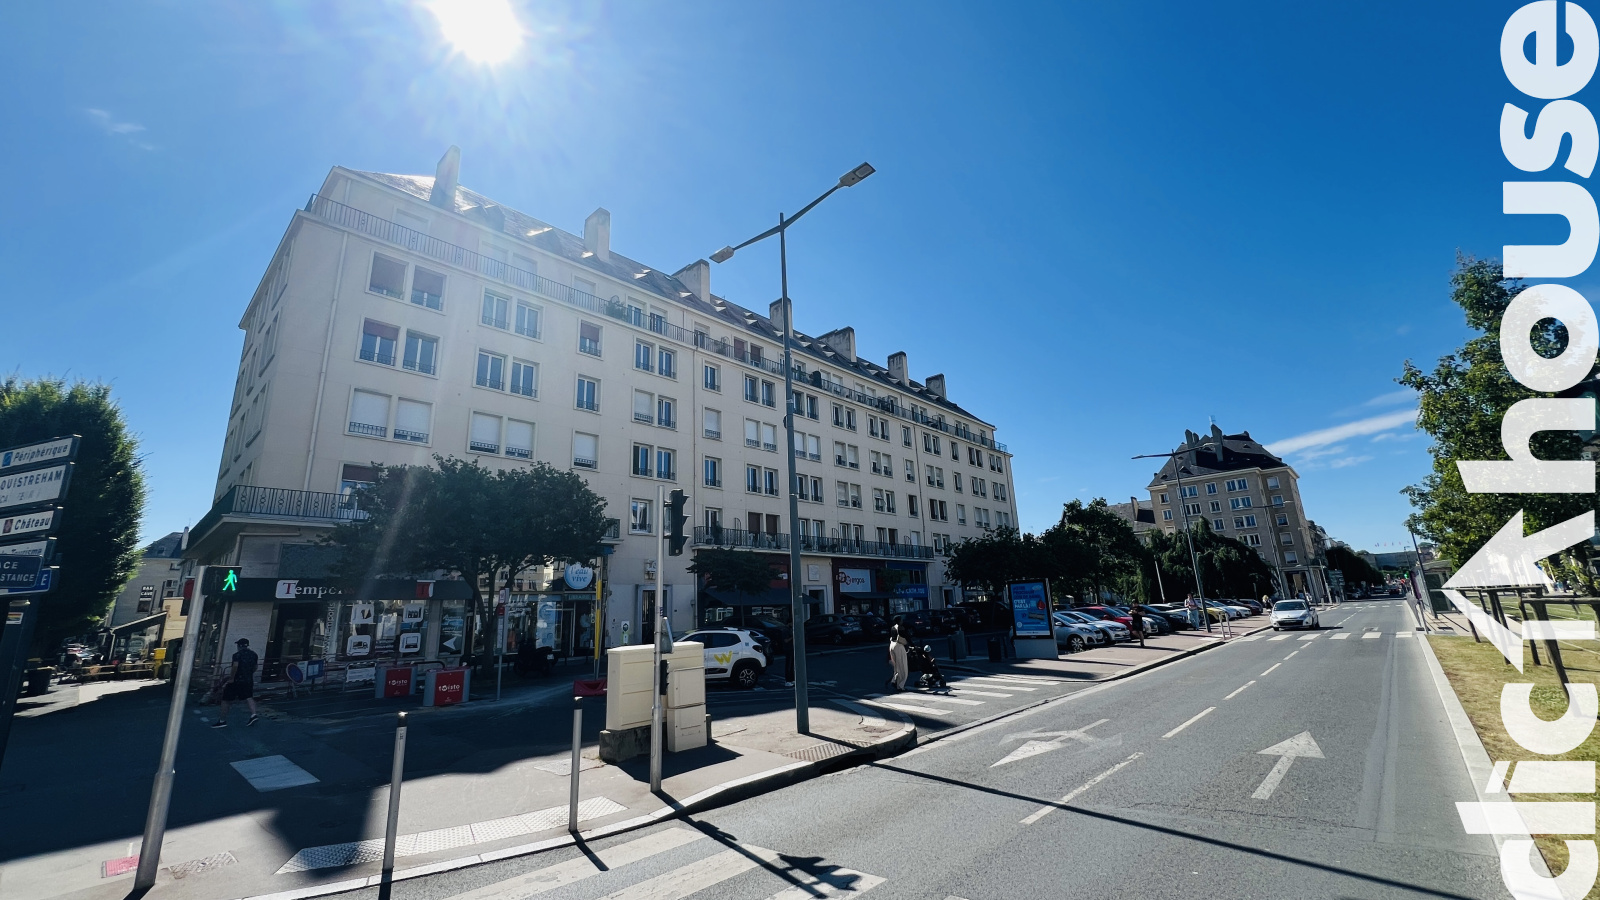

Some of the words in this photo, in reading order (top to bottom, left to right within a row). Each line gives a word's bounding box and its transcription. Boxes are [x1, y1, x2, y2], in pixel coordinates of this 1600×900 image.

[13, 444, 68, 463] Périphérique
[0, 470, 63, 490] OUISTREHAM
[14, 517, 51, 531] Château
[571, 574, 588, 583] vive
